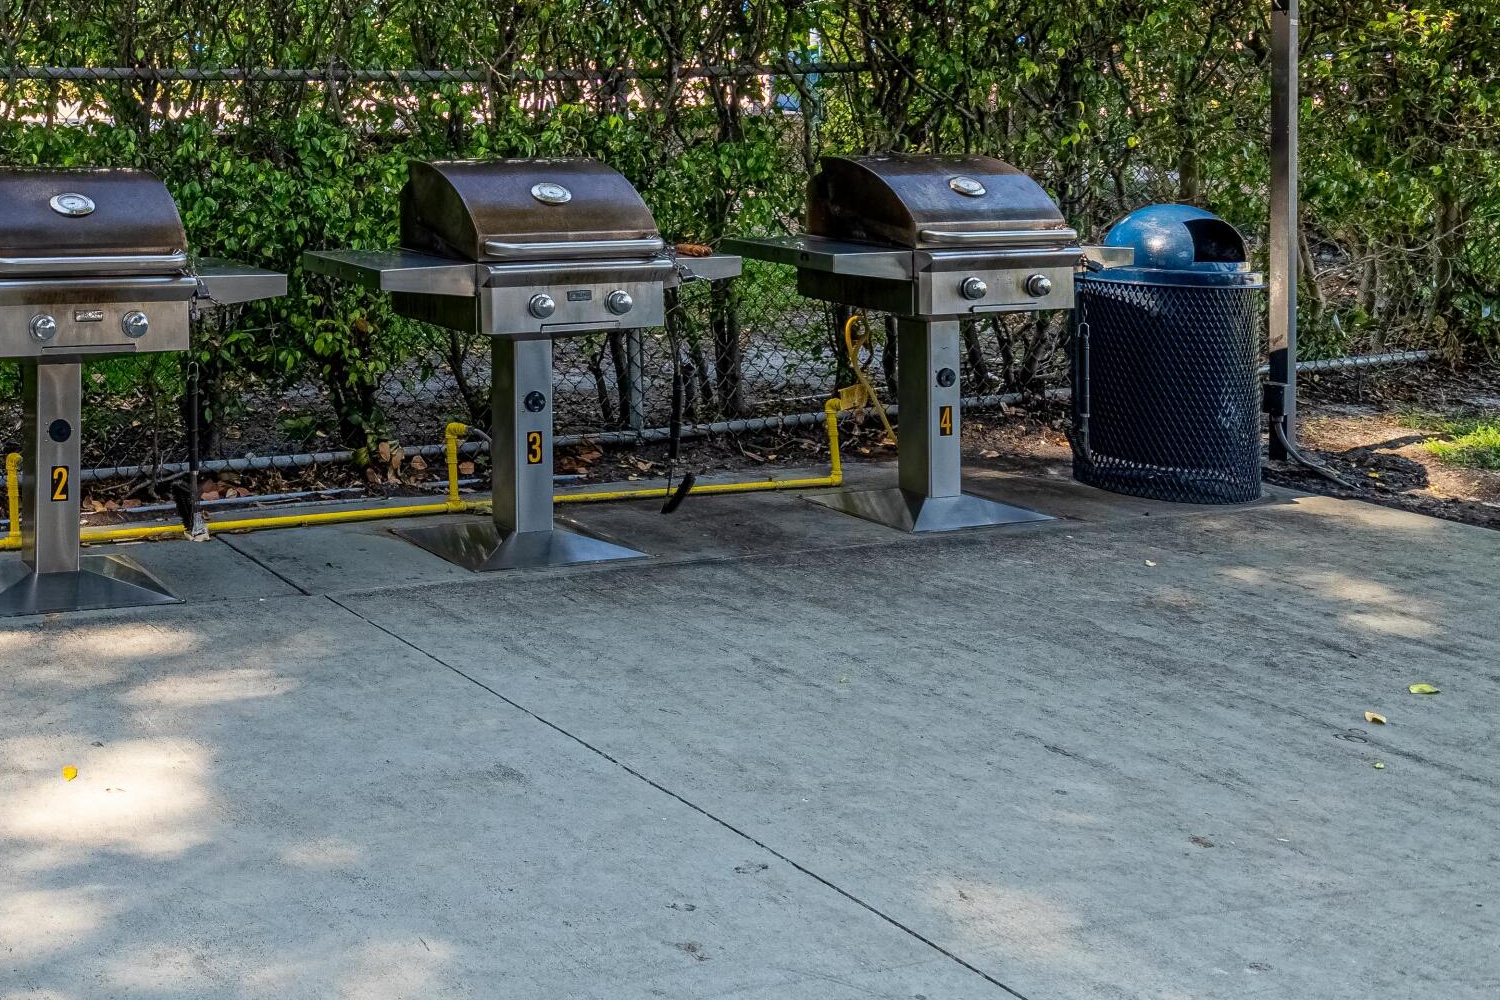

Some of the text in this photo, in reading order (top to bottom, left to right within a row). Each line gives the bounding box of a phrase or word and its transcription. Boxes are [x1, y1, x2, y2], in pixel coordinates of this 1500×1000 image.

[941, 408, 951, 435] 4
[529, 432, 541, 462] 3
[53, 468, 68, 500] 2
